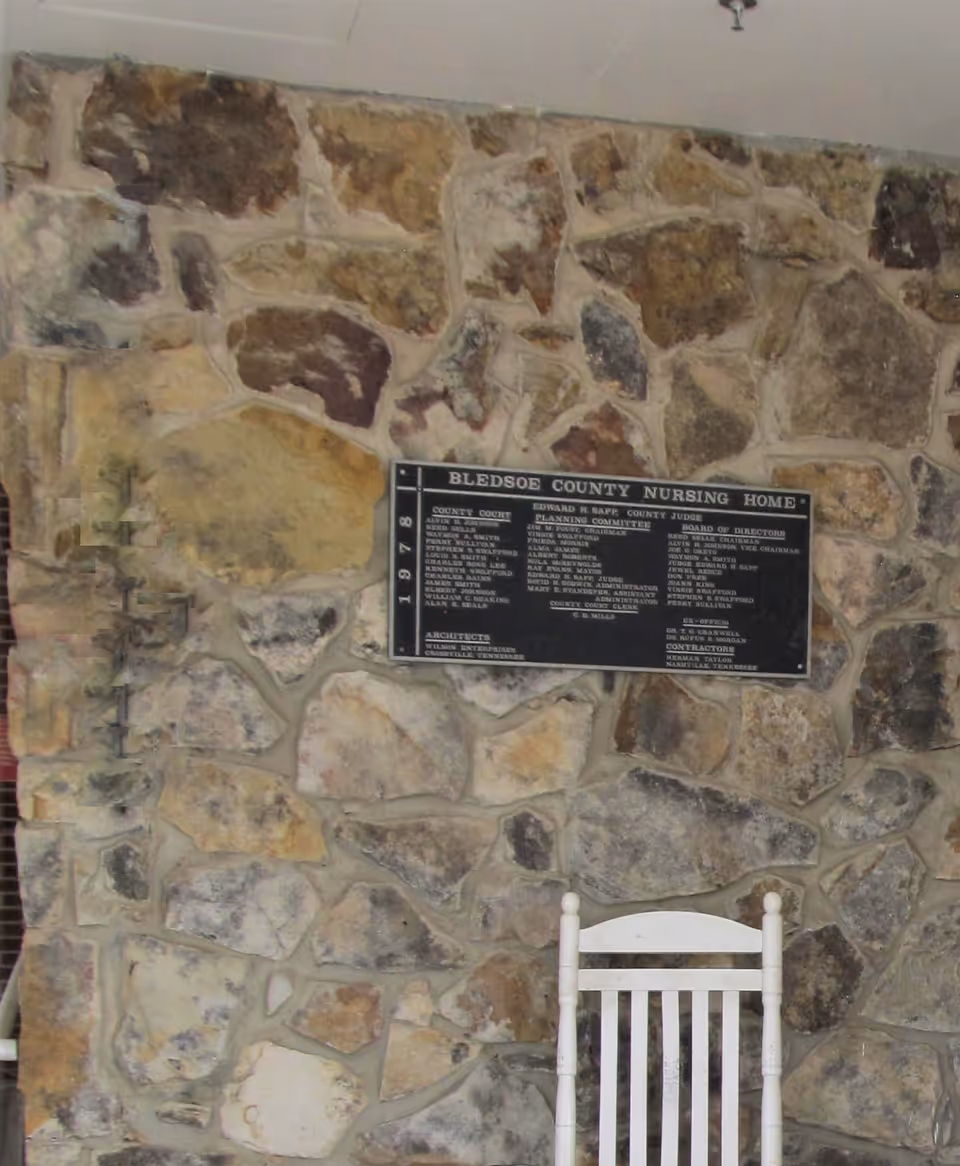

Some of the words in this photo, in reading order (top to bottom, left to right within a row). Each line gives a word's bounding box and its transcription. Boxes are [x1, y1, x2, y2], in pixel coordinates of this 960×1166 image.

[448, 471, 541, 490] BLEDSOE
[551, 479, 631, 497] COUNTY
[643, 486, 729, 505] NURSING
[743, 493, 796, 509] HOME
[432, 506, 474, 516] COUNTY
[479, 509, 512, 519] COURT
[532, 502, 576, 513] EDWARD
[626, 509, 666, 519] COUNTY
[670, 512, 703, 522] JUDGE
[535, 513, 588, 524] PLANNING
[591, 517, 651, 529] COMMITTEE
[682, 524, 714, 533] BOARD
[717, 526, 730, 534] OF
[734, 527, 786, 537] DIRECTORS
[720, 536, 760, 545] CHAIRMAN
[475, 548, 518, 557] SWAFD
[759, 546, 800, 555] CHAIRMAN
[398, 515, 412, 604] 1978
[595, 582, 658, 592] ADMINISTRATOR
[424, 593, 462, 601] WILLIAM
[595, 596, 659, 605] ADMINISTRATOR
[425, 631, 491, 641] ARCHITECTS
[665, 643, 735, 653] CONTRACTORS
